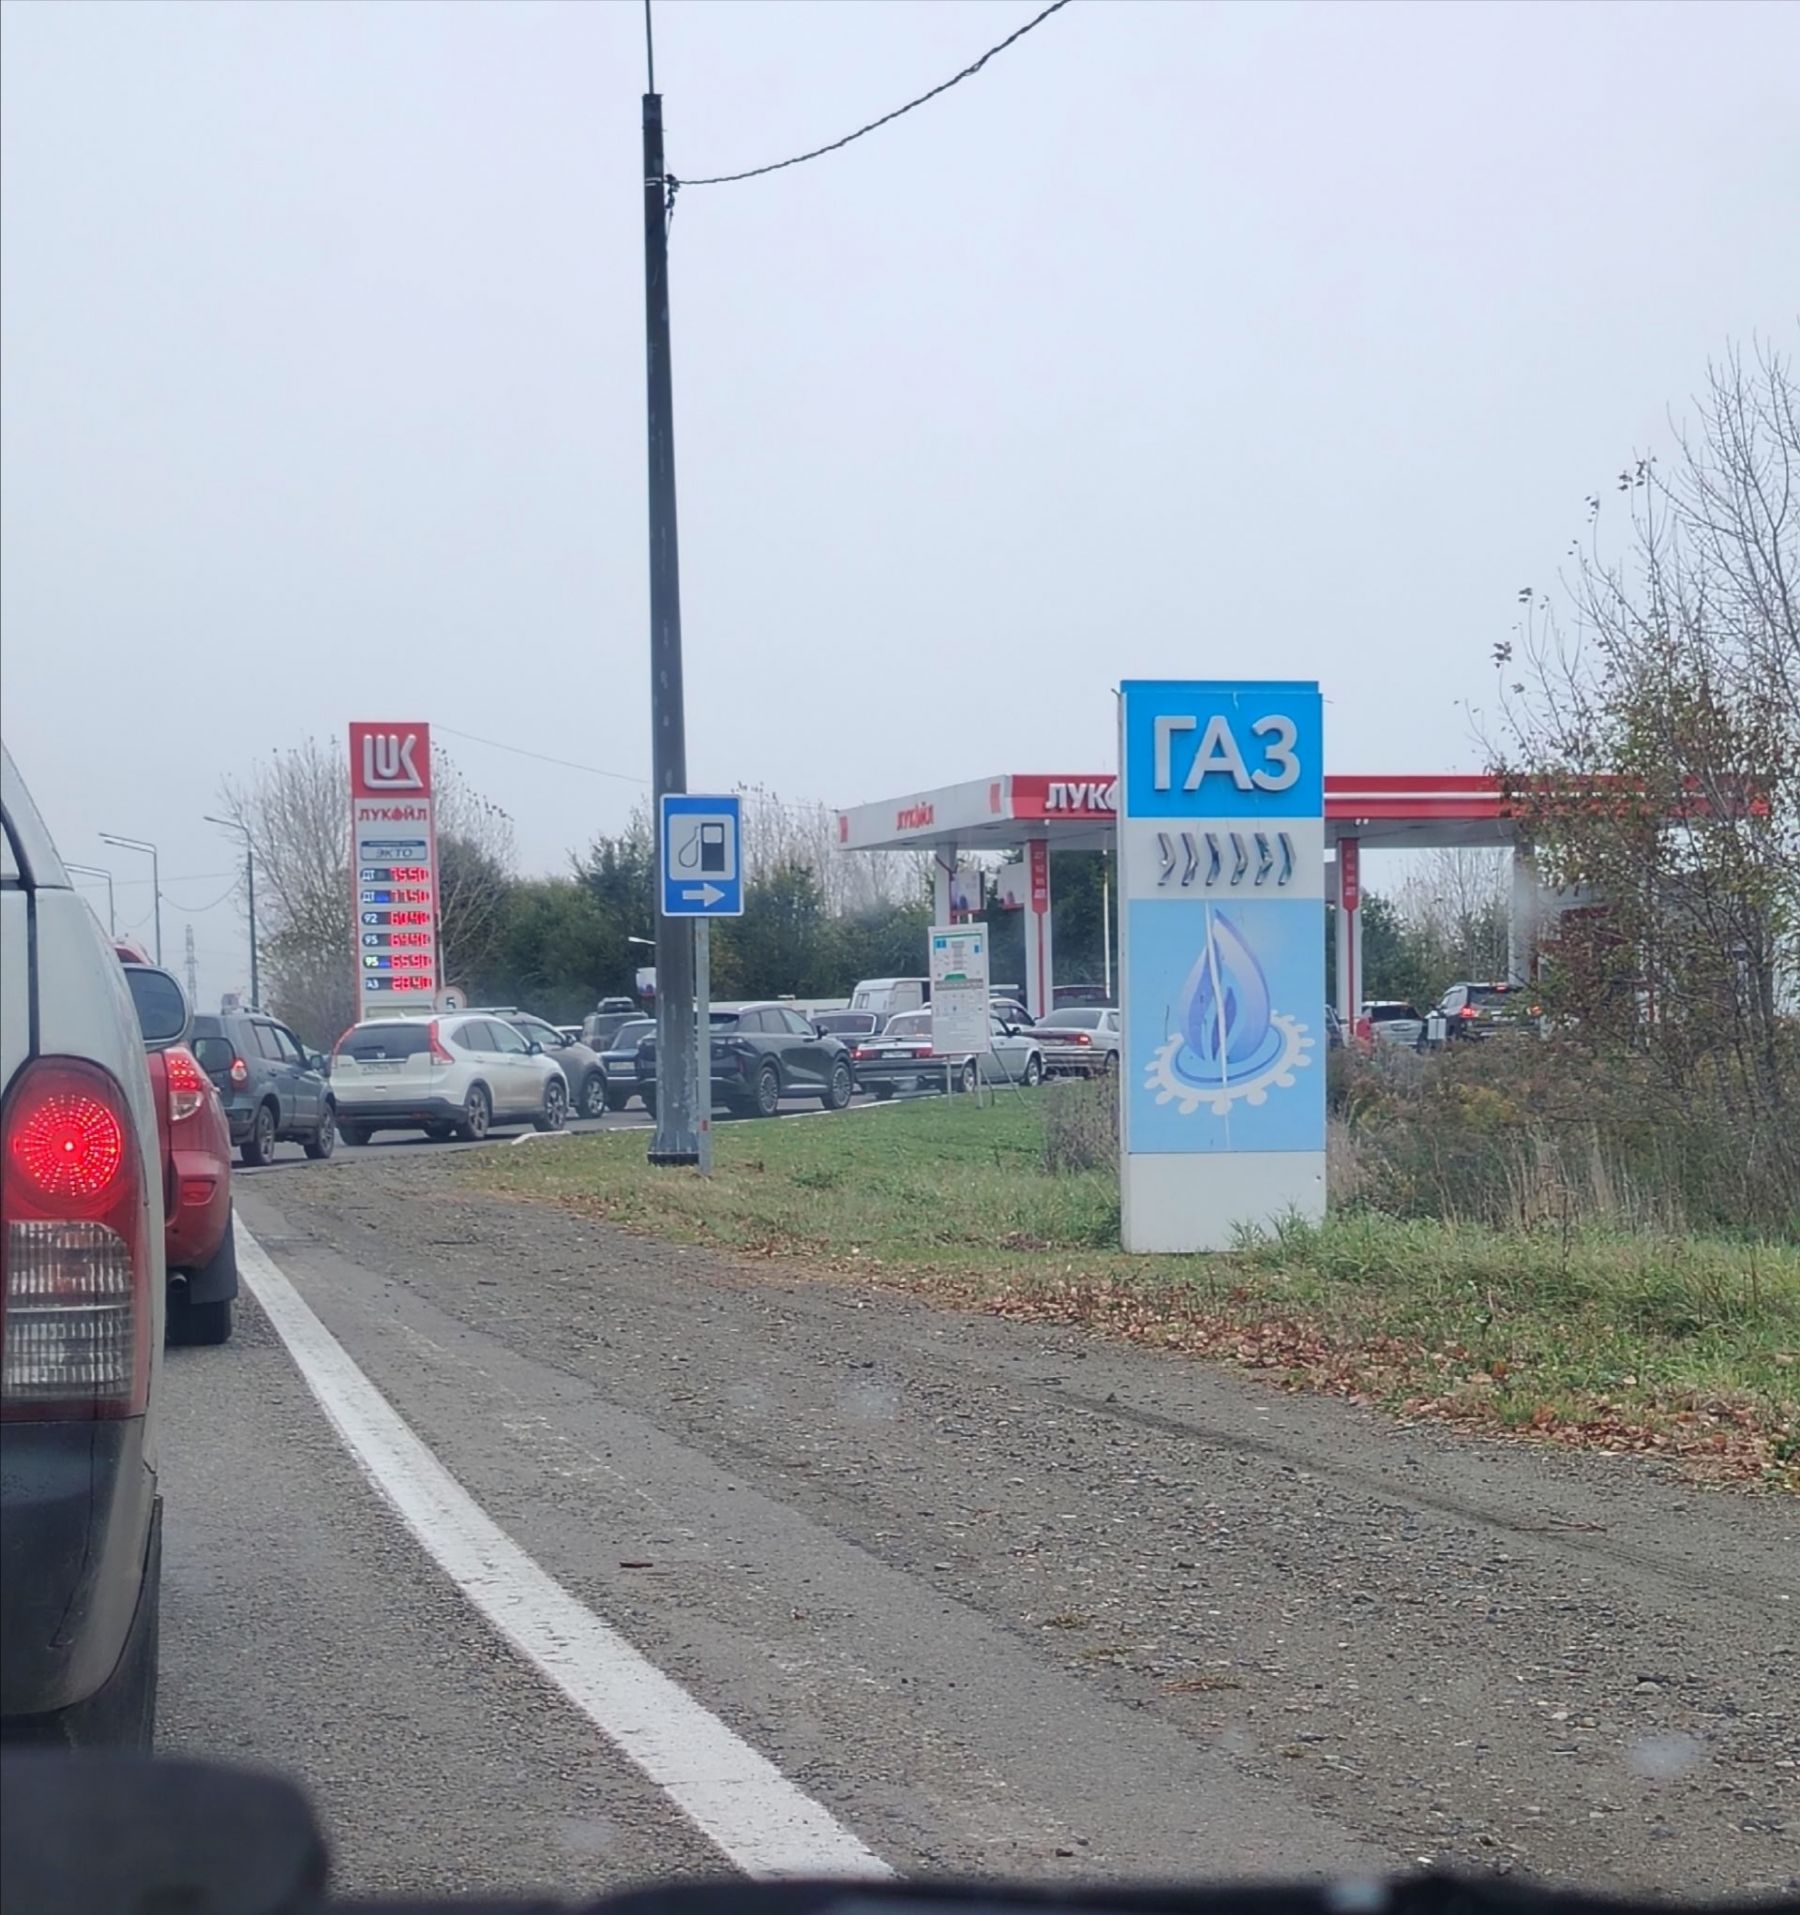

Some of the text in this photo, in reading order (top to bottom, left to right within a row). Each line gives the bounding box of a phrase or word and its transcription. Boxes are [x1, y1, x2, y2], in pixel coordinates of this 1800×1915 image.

[1154, 714, 1300, 791] ГАЗ
[363, 734, 424, 789] LUK
[364, 913, 377, 923] 92
[364, 935, 378, 944] 95
[365, 956, 379, 966] 95
[446, 996, 456, 1010] 5
